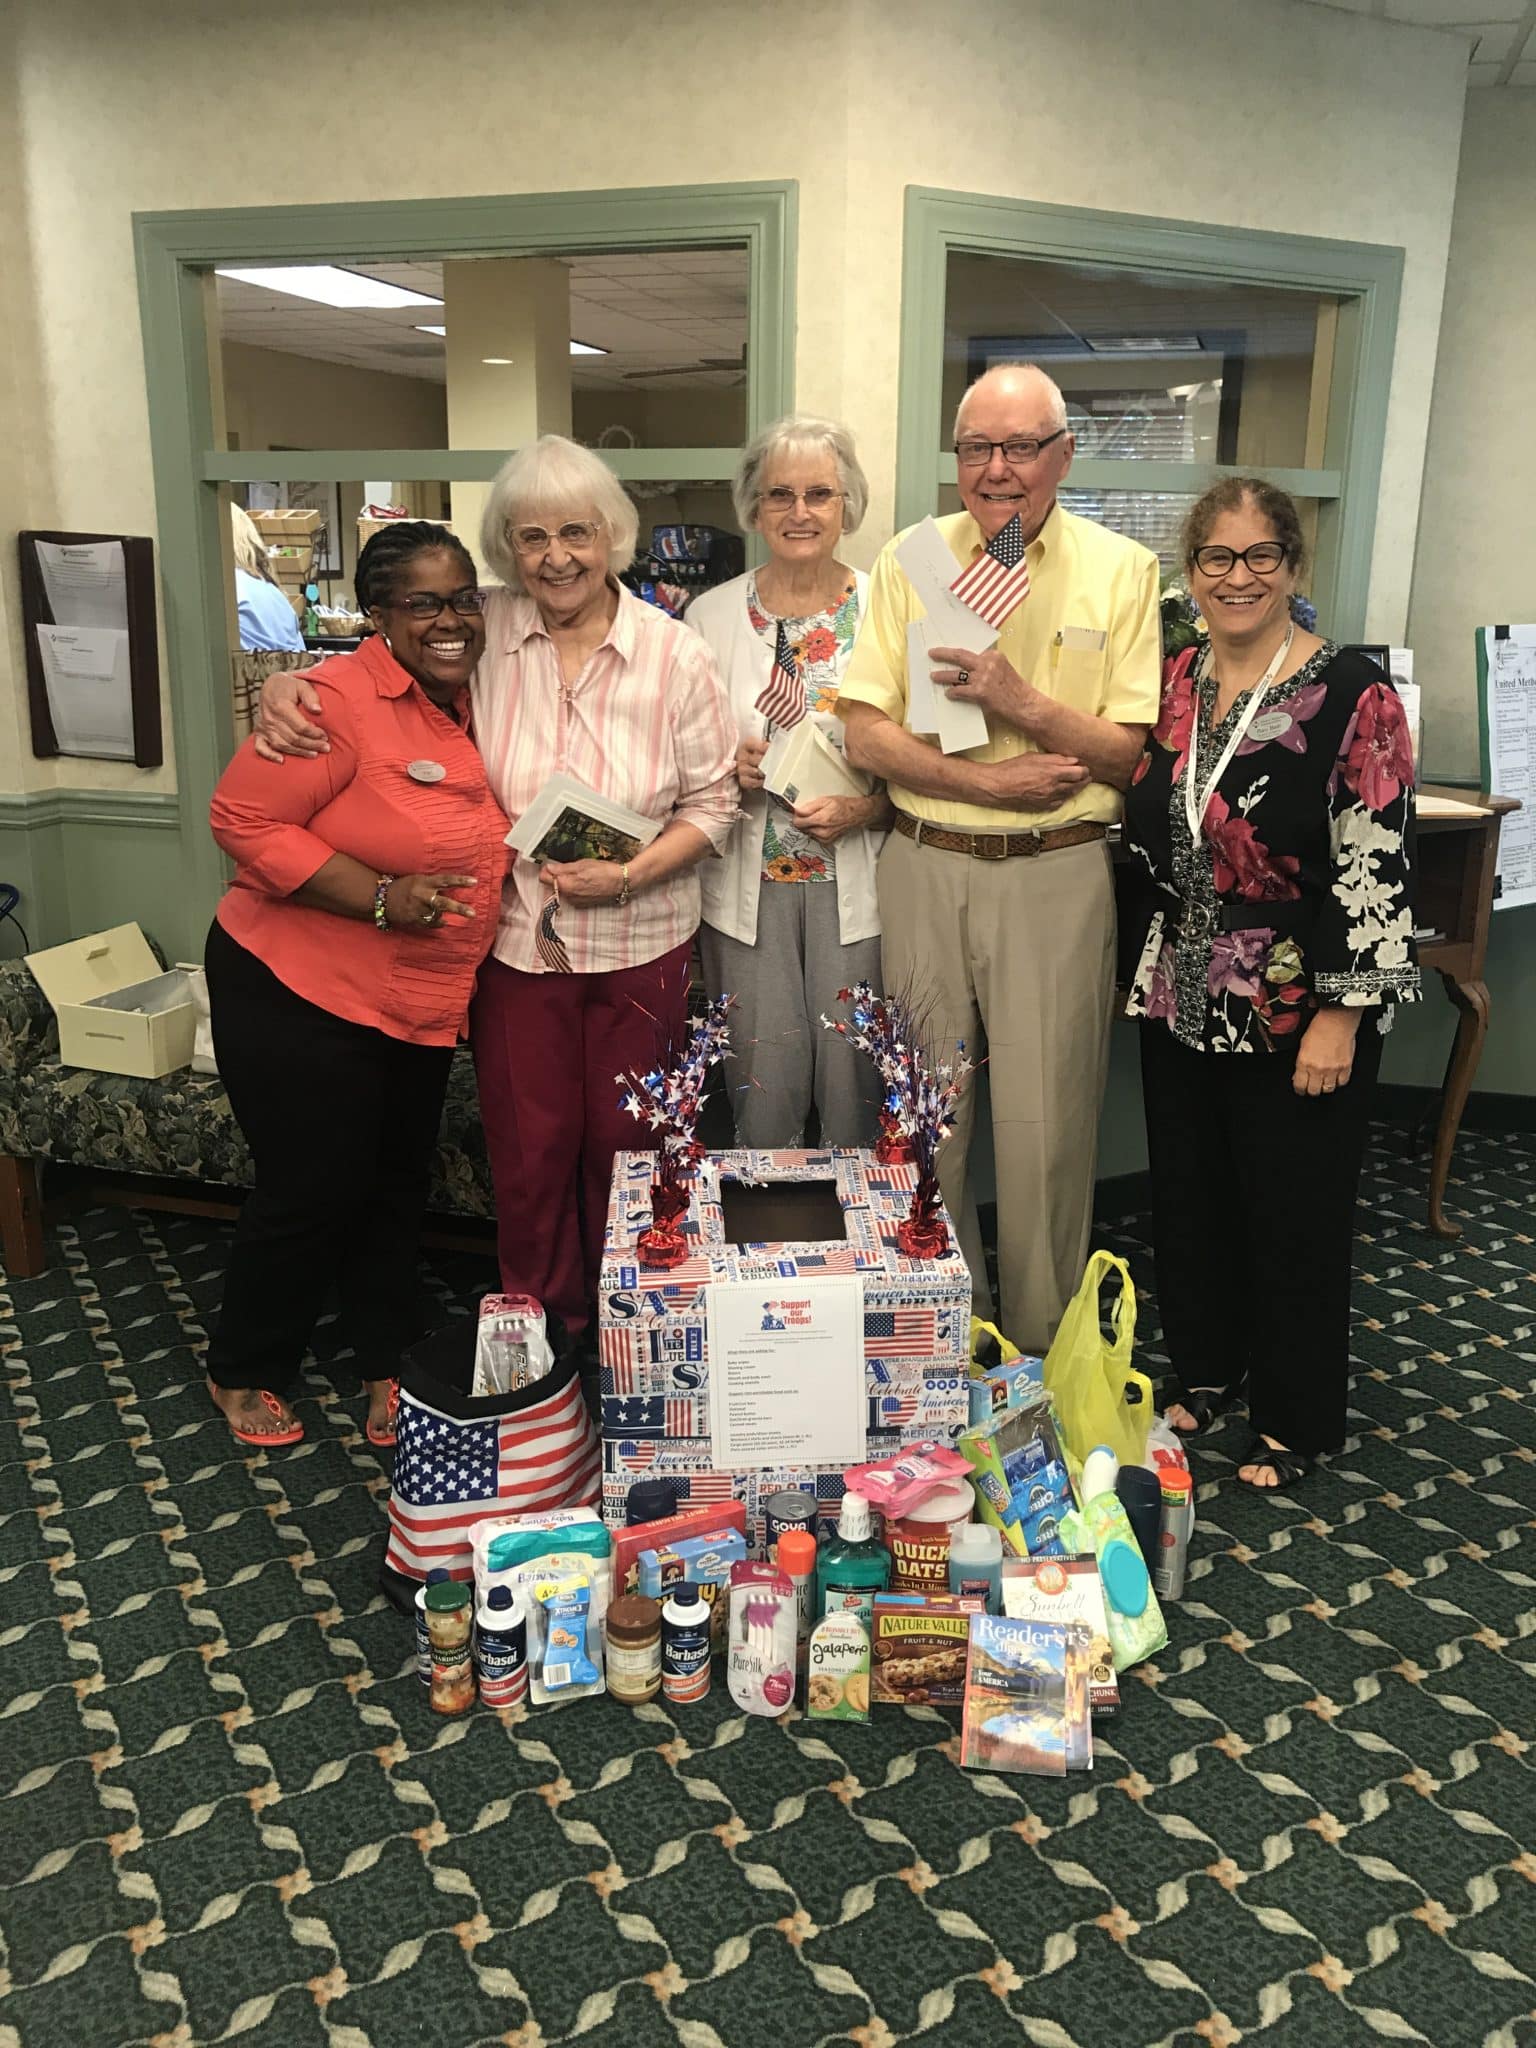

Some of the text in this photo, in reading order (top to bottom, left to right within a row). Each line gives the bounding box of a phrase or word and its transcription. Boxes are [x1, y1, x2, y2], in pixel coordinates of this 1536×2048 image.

[780, 1299, 811, 1309] Support
[783, 1315, 811, 1325] Troops!
[760, 1473, 816, 1483] AMERICA
[603, 1484, 625, 1495] RED
[771, 1520, 807, 1532] GOYA
[893, 1539, 951, 1561] QUICK
[896, 1558, 946, 1578] OATS
[1025, 1593, 1085, 1612] Sunbelt
[883, 1617, 969, 1634] NATURE VALLE
[979, 1618, 1065, 1648] Reader's
[665, 1641, 709, 1660] Barbasol
[978, 1676, 1008, 1688] AMERICA
